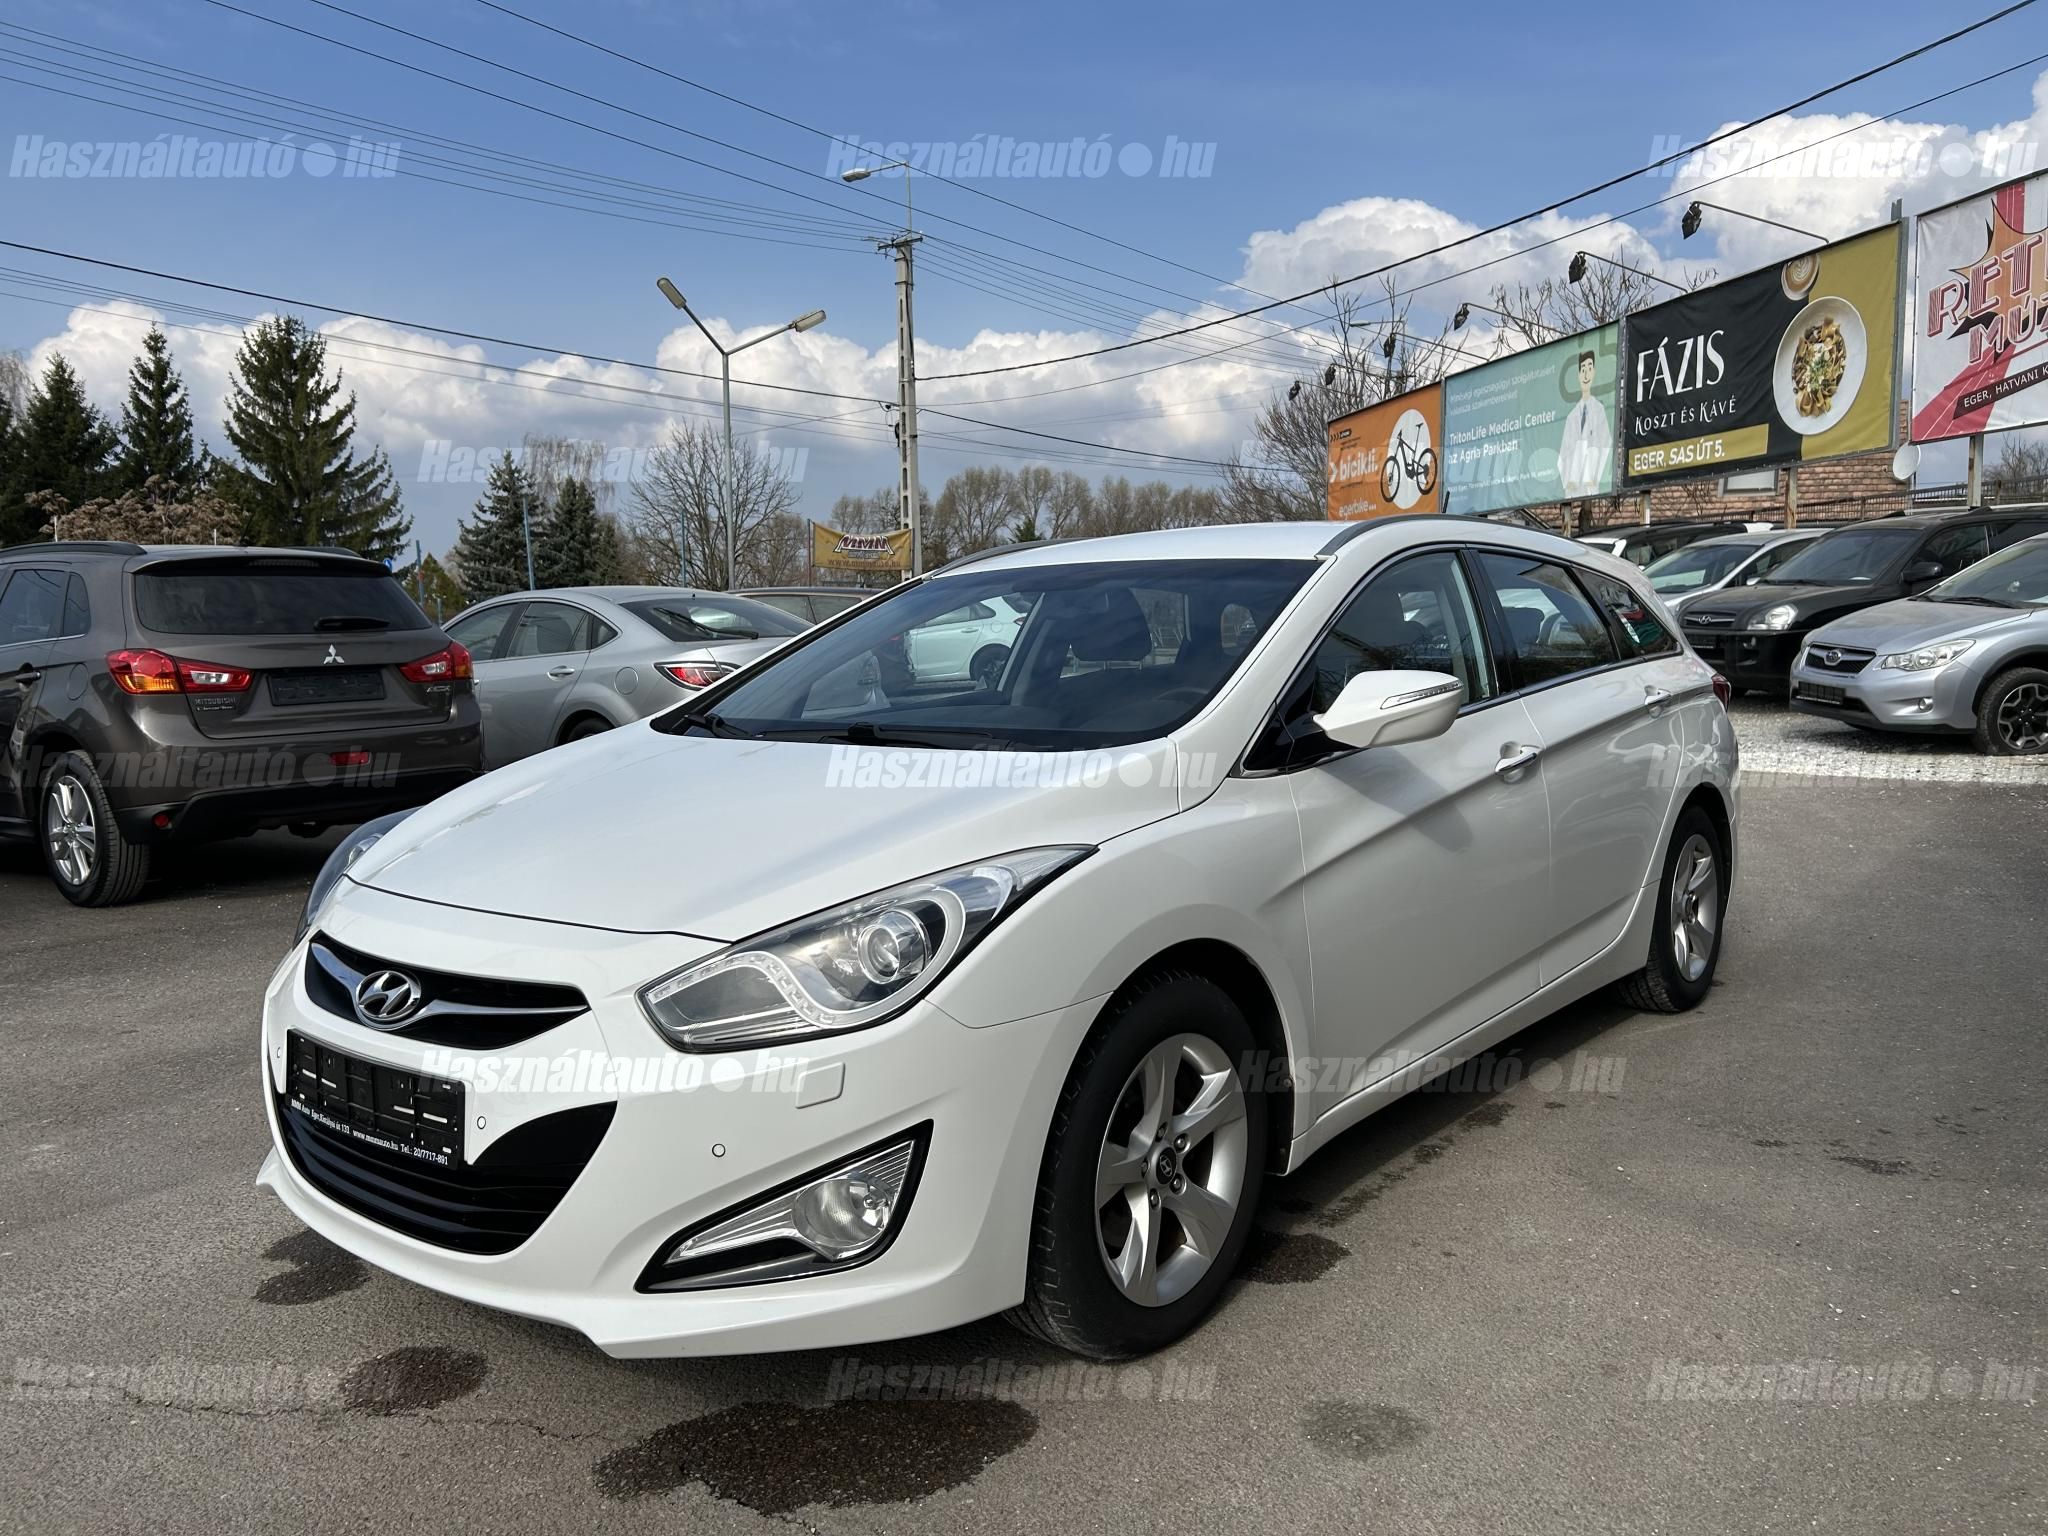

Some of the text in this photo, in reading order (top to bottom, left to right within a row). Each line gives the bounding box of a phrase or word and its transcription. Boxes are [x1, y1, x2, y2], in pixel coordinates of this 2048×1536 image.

[1927, 233, 2048, 337] RET
[1636, 330, 1725, 403] FÁZIS
[1964, 391, 1993, 408] EGER,
[1995, 369, 2039, 394] HATVANI
[1450, 410, 1556, 446] TritonLife Medical Center
[1459, 446, 1481, 463] Agria
[1483, 439, 1519, 457] Parkban
[1634, 450, 1666, 471] EGER,
[1668, 445, 1694, 465] SAS
[1695, 437, 1714, 460] ÚT
[1714, 439, 1726, 458] 5.
